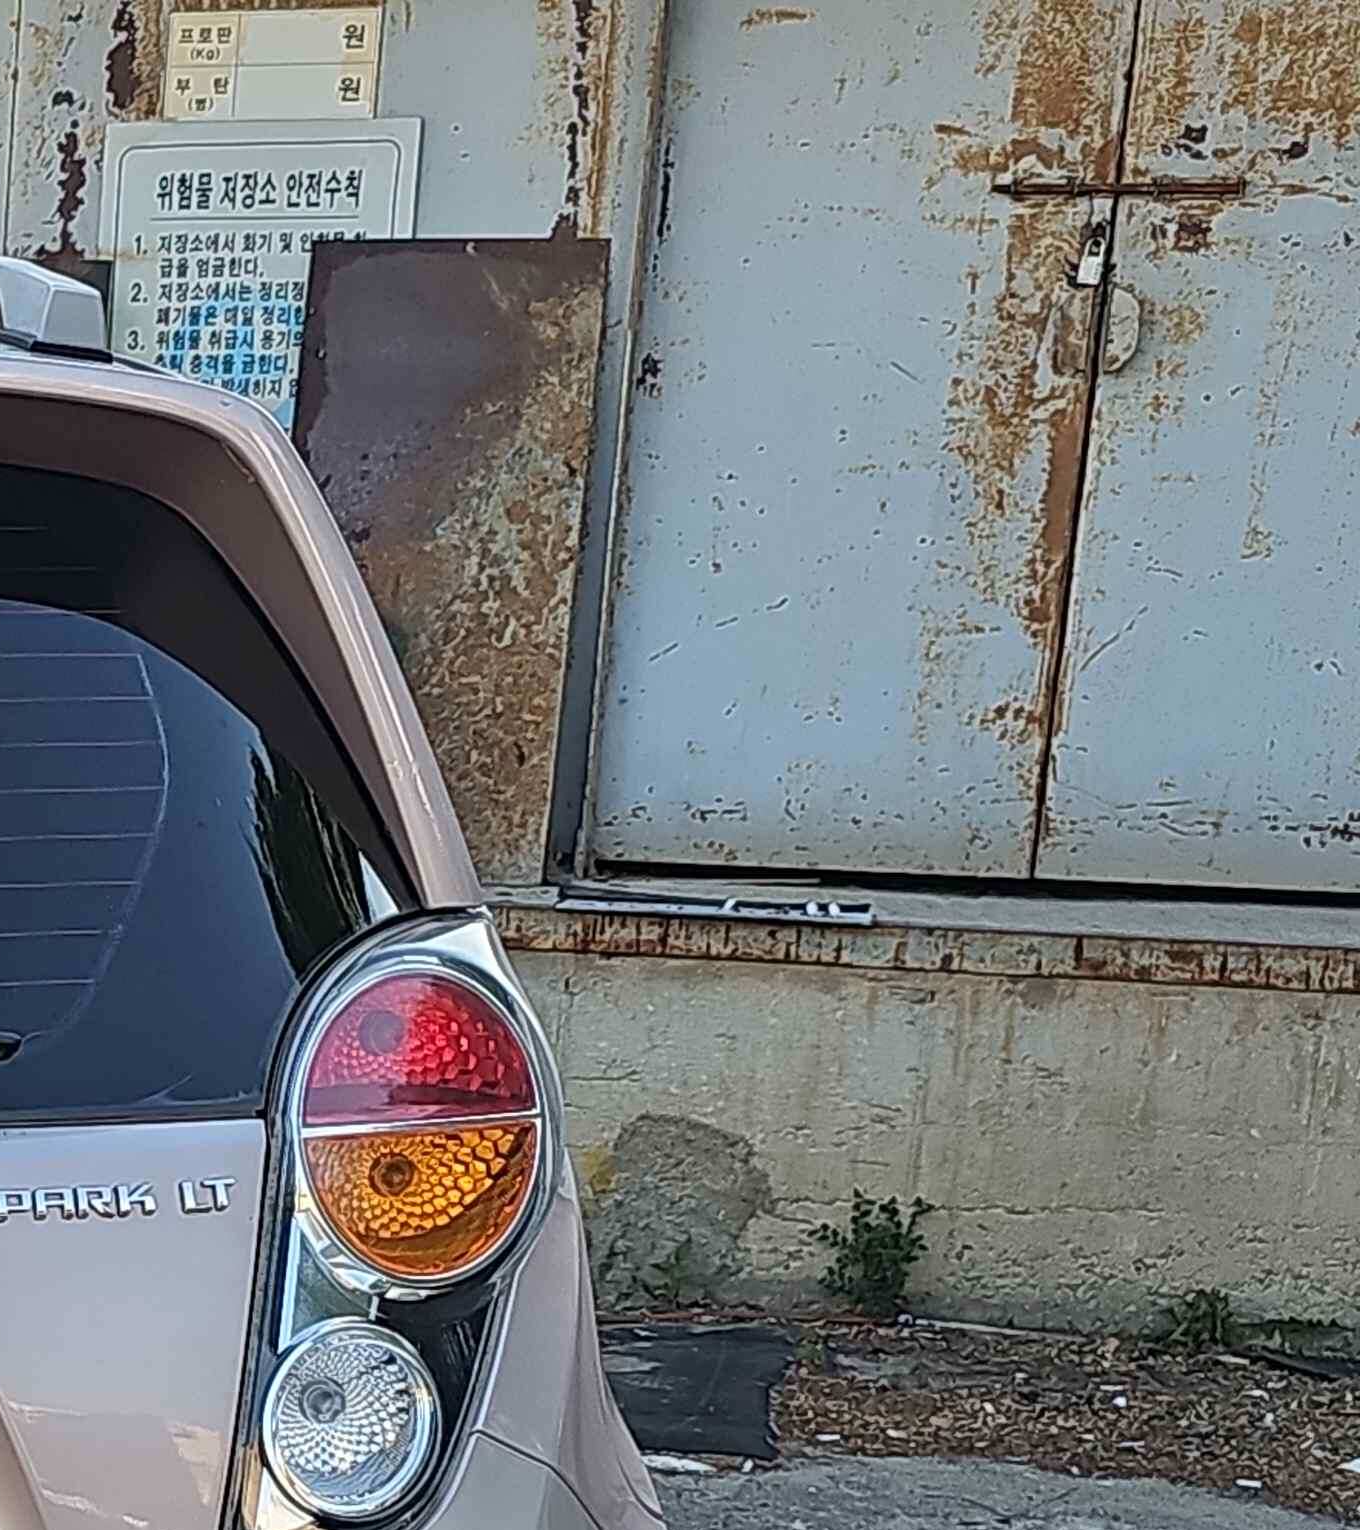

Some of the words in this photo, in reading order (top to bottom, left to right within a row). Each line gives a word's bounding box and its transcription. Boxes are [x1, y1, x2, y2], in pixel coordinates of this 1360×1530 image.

[178, 26, 232, 44] 프로판
[342, 24, 366, 50] 원
[338, 77, 361, 102] 원
[156, 171, 213, 211] 위험물
[219, 170, 277, 210] 저장소
[285, 168, 363, 209] 안전수칙
[133, 234, 148, 256] 1.
[160, 257, 189, 279] 급을
[130, 282, 148, 304] 2.
[127, 330, 146, 351] 3.
[178, 1176, 237, 1214] LT
